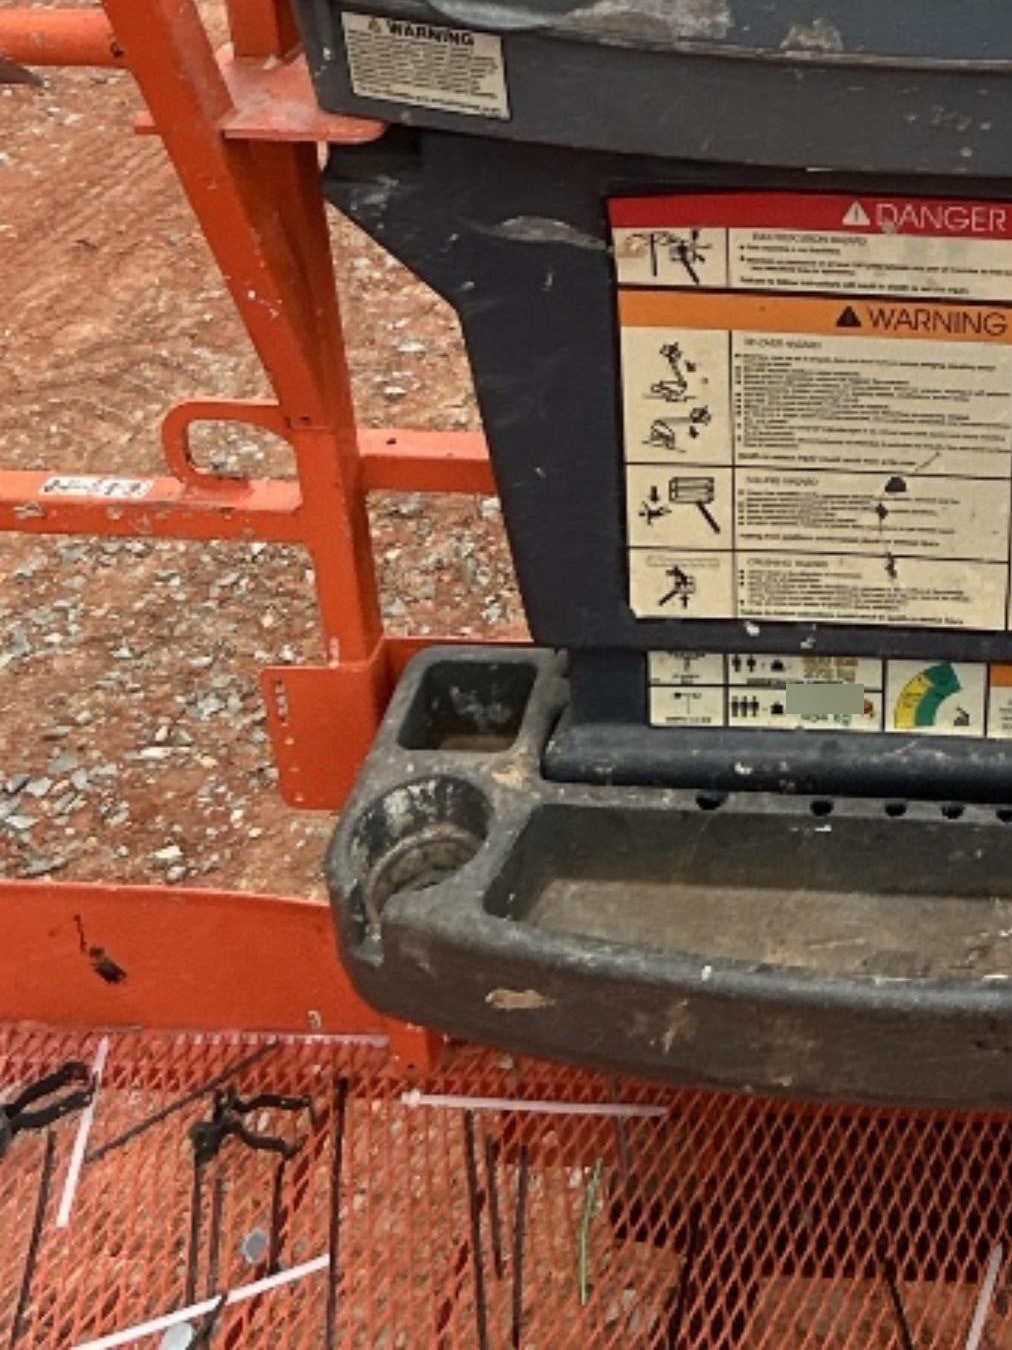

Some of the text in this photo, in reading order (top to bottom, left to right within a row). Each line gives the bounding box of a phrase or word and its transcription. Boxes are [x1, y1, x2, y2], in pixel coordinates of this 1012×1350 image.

[386, 19, 475, 46] WARNING
[875, 202, 1007, 232] DANGER
[868, 306, 1009, 336] WARNING
